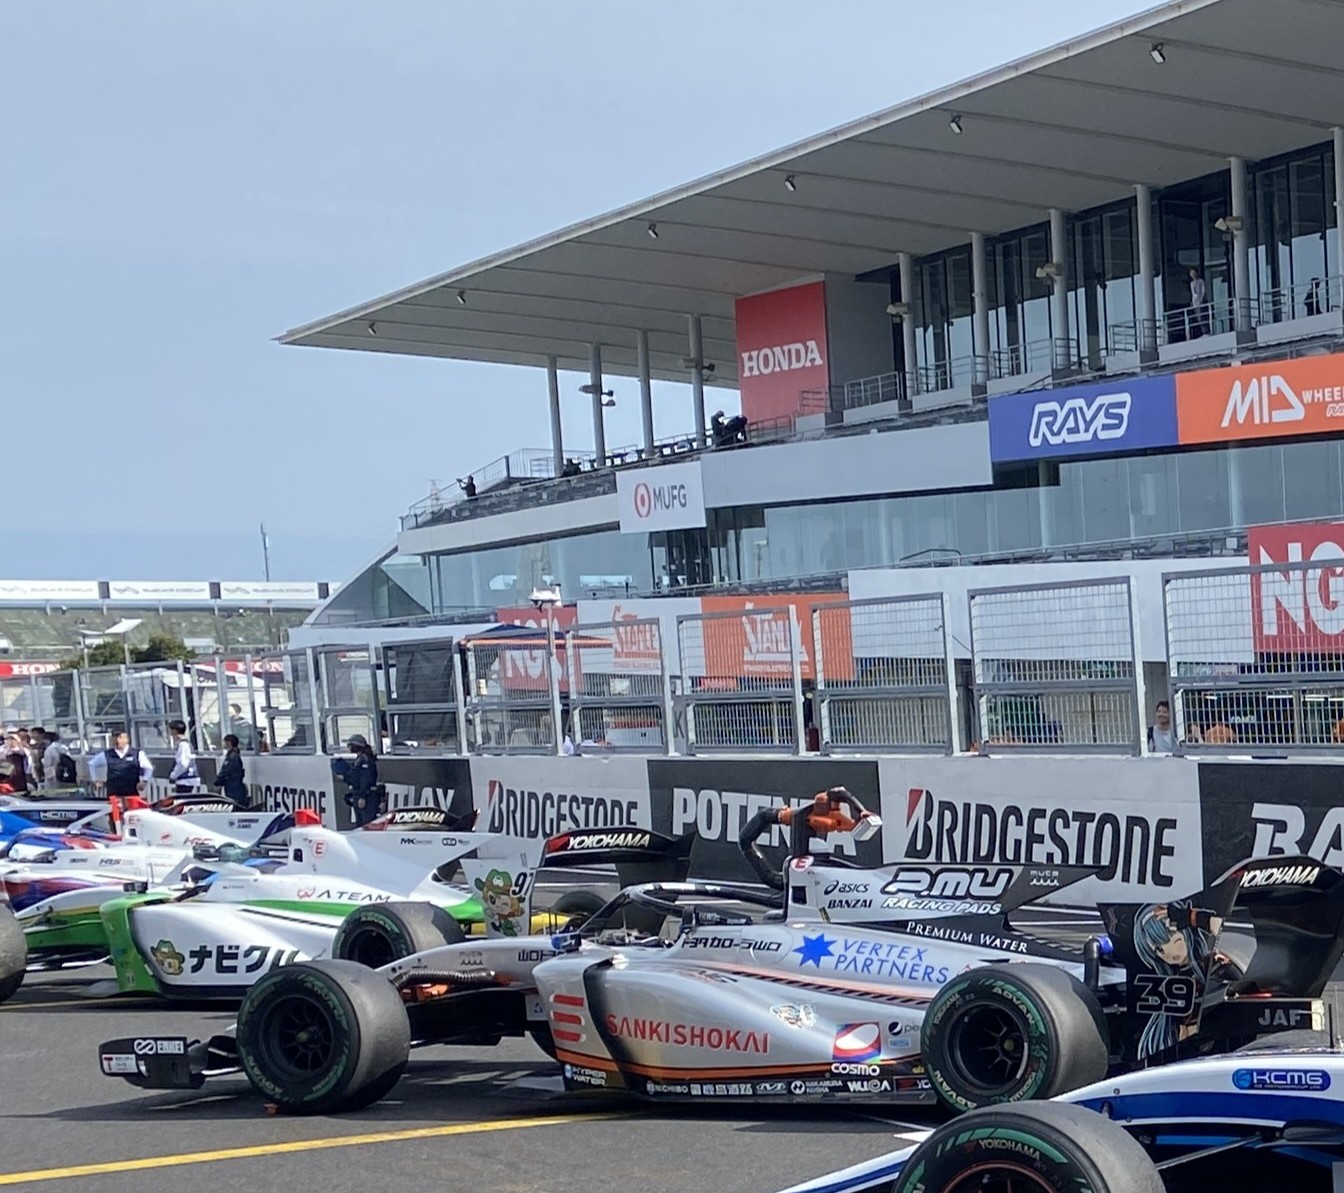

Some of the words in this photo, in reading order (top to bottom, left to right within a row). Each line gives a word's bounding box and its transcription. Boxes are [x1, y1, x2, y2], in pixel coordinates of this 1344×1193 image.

[741, 340, 823, 377] HONDA
[1028, 392, 1131, 447] RAYS
[653, 483, 687, 511] MUFG
[393, 811, 446, 825] YOKOHAMA
[566, 832, 651, 850] YOKOHAMA
[904, 788, 1178, 887] BRIDGESTONE
[838, 882, 869, 893] asics
[1240, 865, 1321, 887] YOKOHAMA
[828, 899, 873, 909] BANZAI
[882, 897, 953, 912] RACING
[954, 902, 1002, 917] PADS
[906, 921, 973, 943] PREMIUM
[980, 933, 1028, 953] WATER
[842, 938, 929, 963] VERTEX
[834, 954, 949, 986] PARTNERS
[992, 987, 1036, 1026] ADVAN
[1133, 975, 1197, 1018] 39
[1258, 1008, 1301, 1027] JAF
[605, 1014, 770, 1055] SANKISHOKAI
[831, 1062, 881, 1076] COSMO
[1251, 1071, 1323, 1085] KCMG
[978, 1138, 1041, 1162] YOKOHAMA
